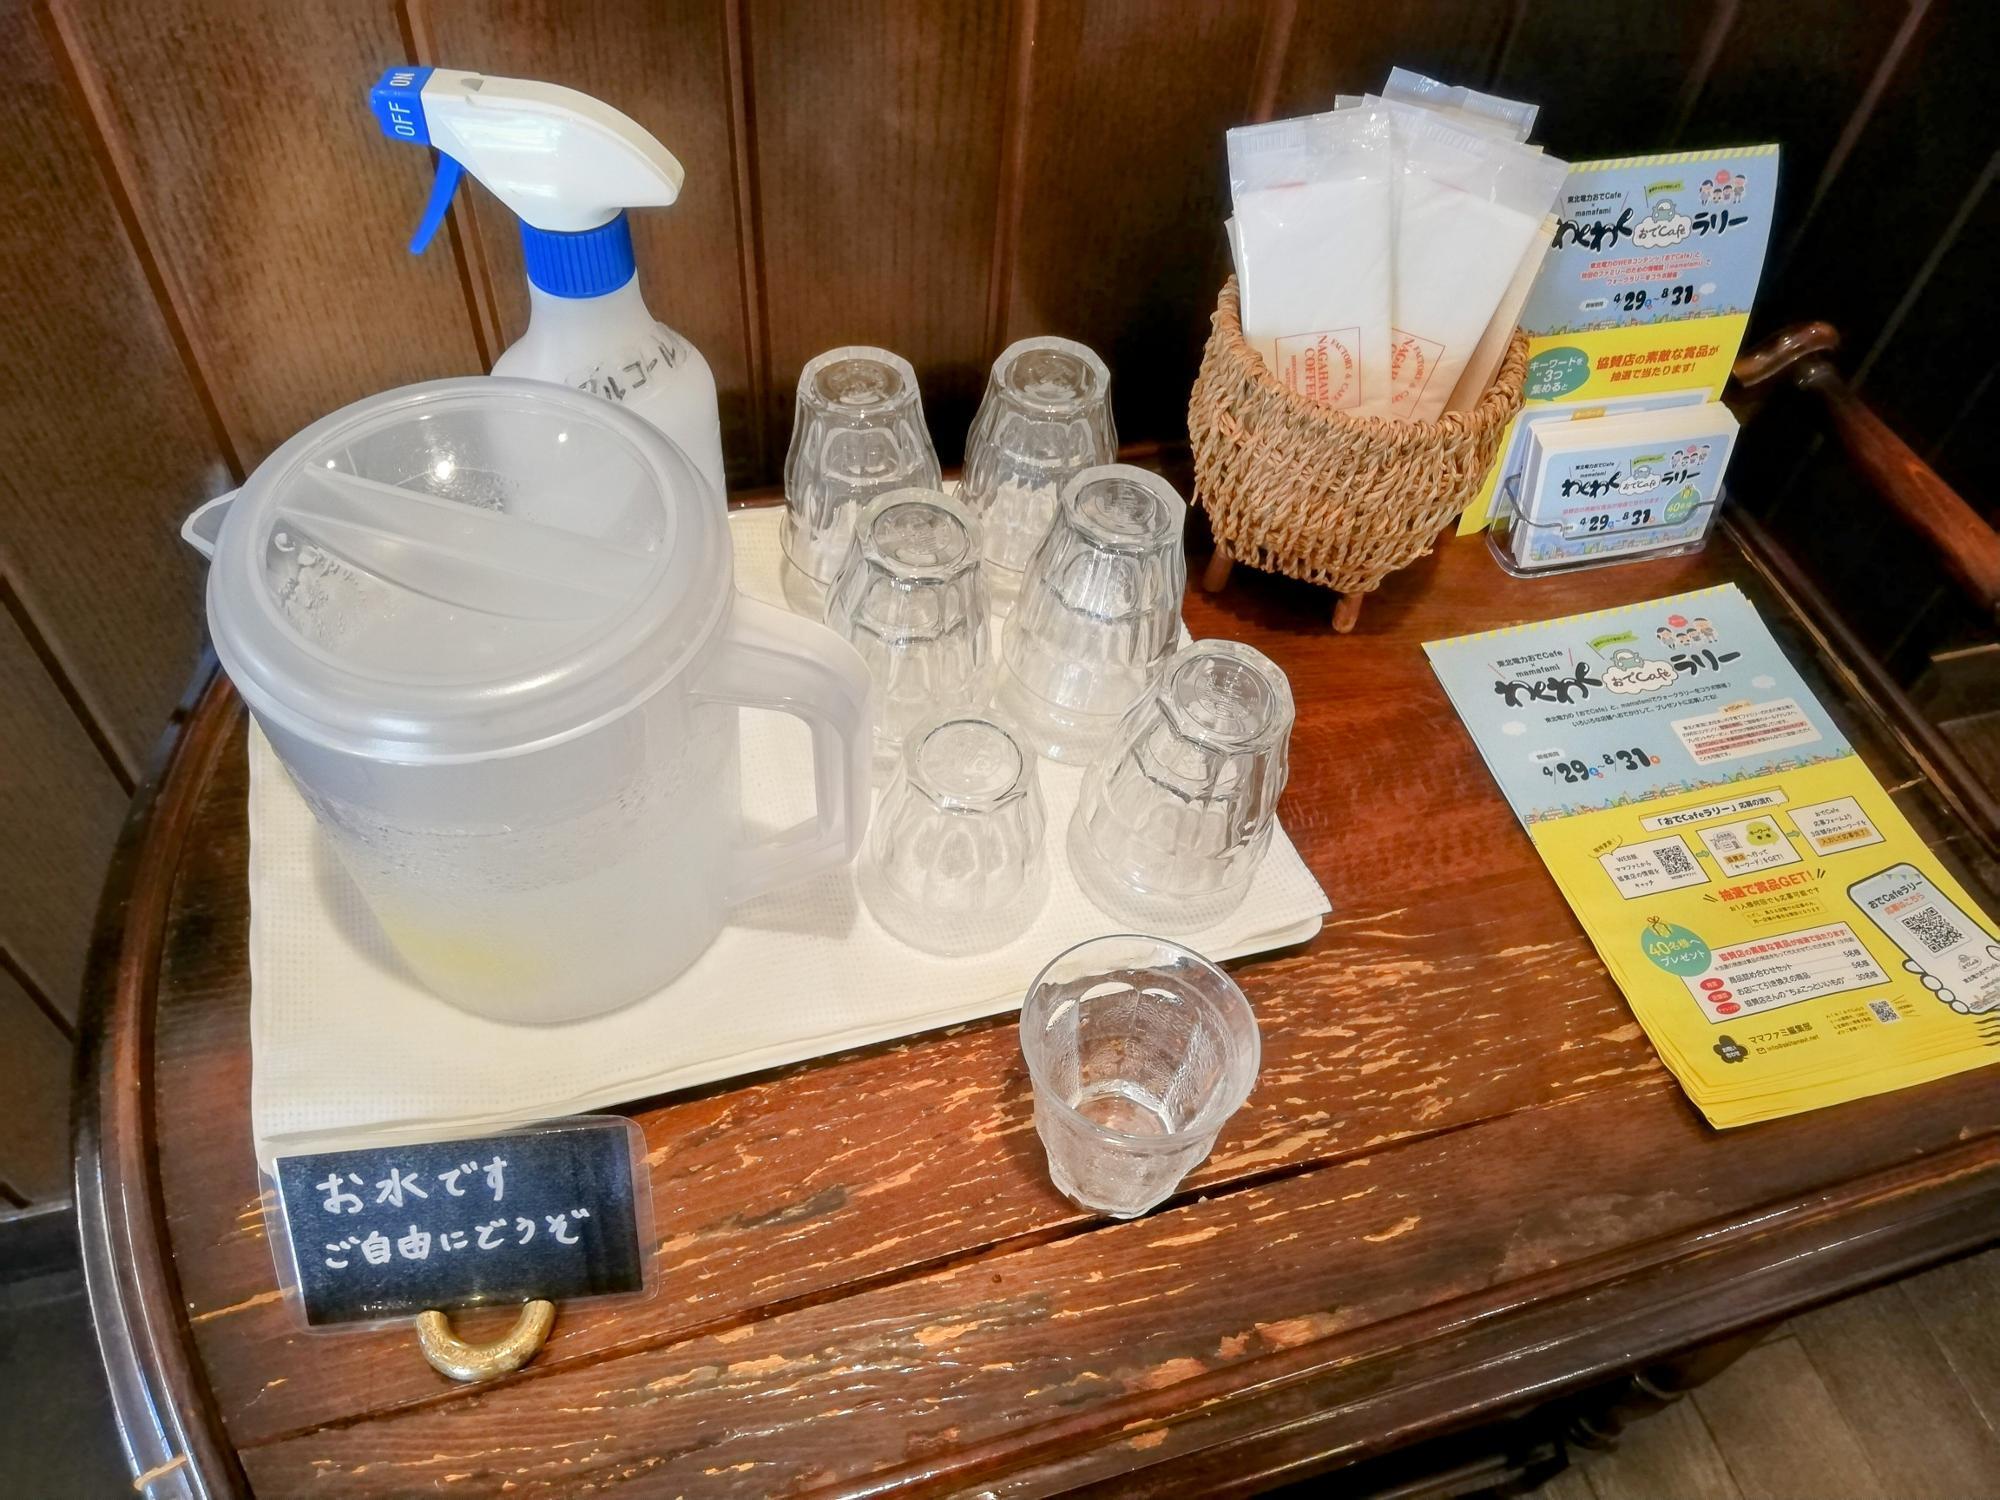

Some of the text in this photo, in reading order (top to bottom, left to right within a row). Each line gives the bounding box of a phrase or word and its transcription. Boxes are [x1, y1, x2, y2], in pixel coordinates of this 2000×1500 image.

[390, 73, 415, 87] ON
[388, 101, 415, 136] OFF
[1575, 208, 1611, 217] mamafami
[1692, 210, 1749, 236] ラリー
[1318, 335, 1328, 402] NAGAHAM
[1596, 345, 1720, 371] 協賛店の素敵な賞品が
[1529, 381, 1568, 396] 集めると
[1661, 470, 1701, 486] ラリー
[1496, 650, 1563, 667] 東北電力おでCafe
[1516, 663, 1561, 678] mamafami
[1495, 649, 1742, 708] わくわく おでCafe ラリー
[1718, 870, 1815, 902] 抽選で賞品GET!
[1868, 880, 1923, 909] おでCafeラリー
[1660, 950, 1705, 967] プレゼント
[316, 1155, 508, 1214] お水です
[325, 1207, 591, 1270] ご自由にどうぞ
